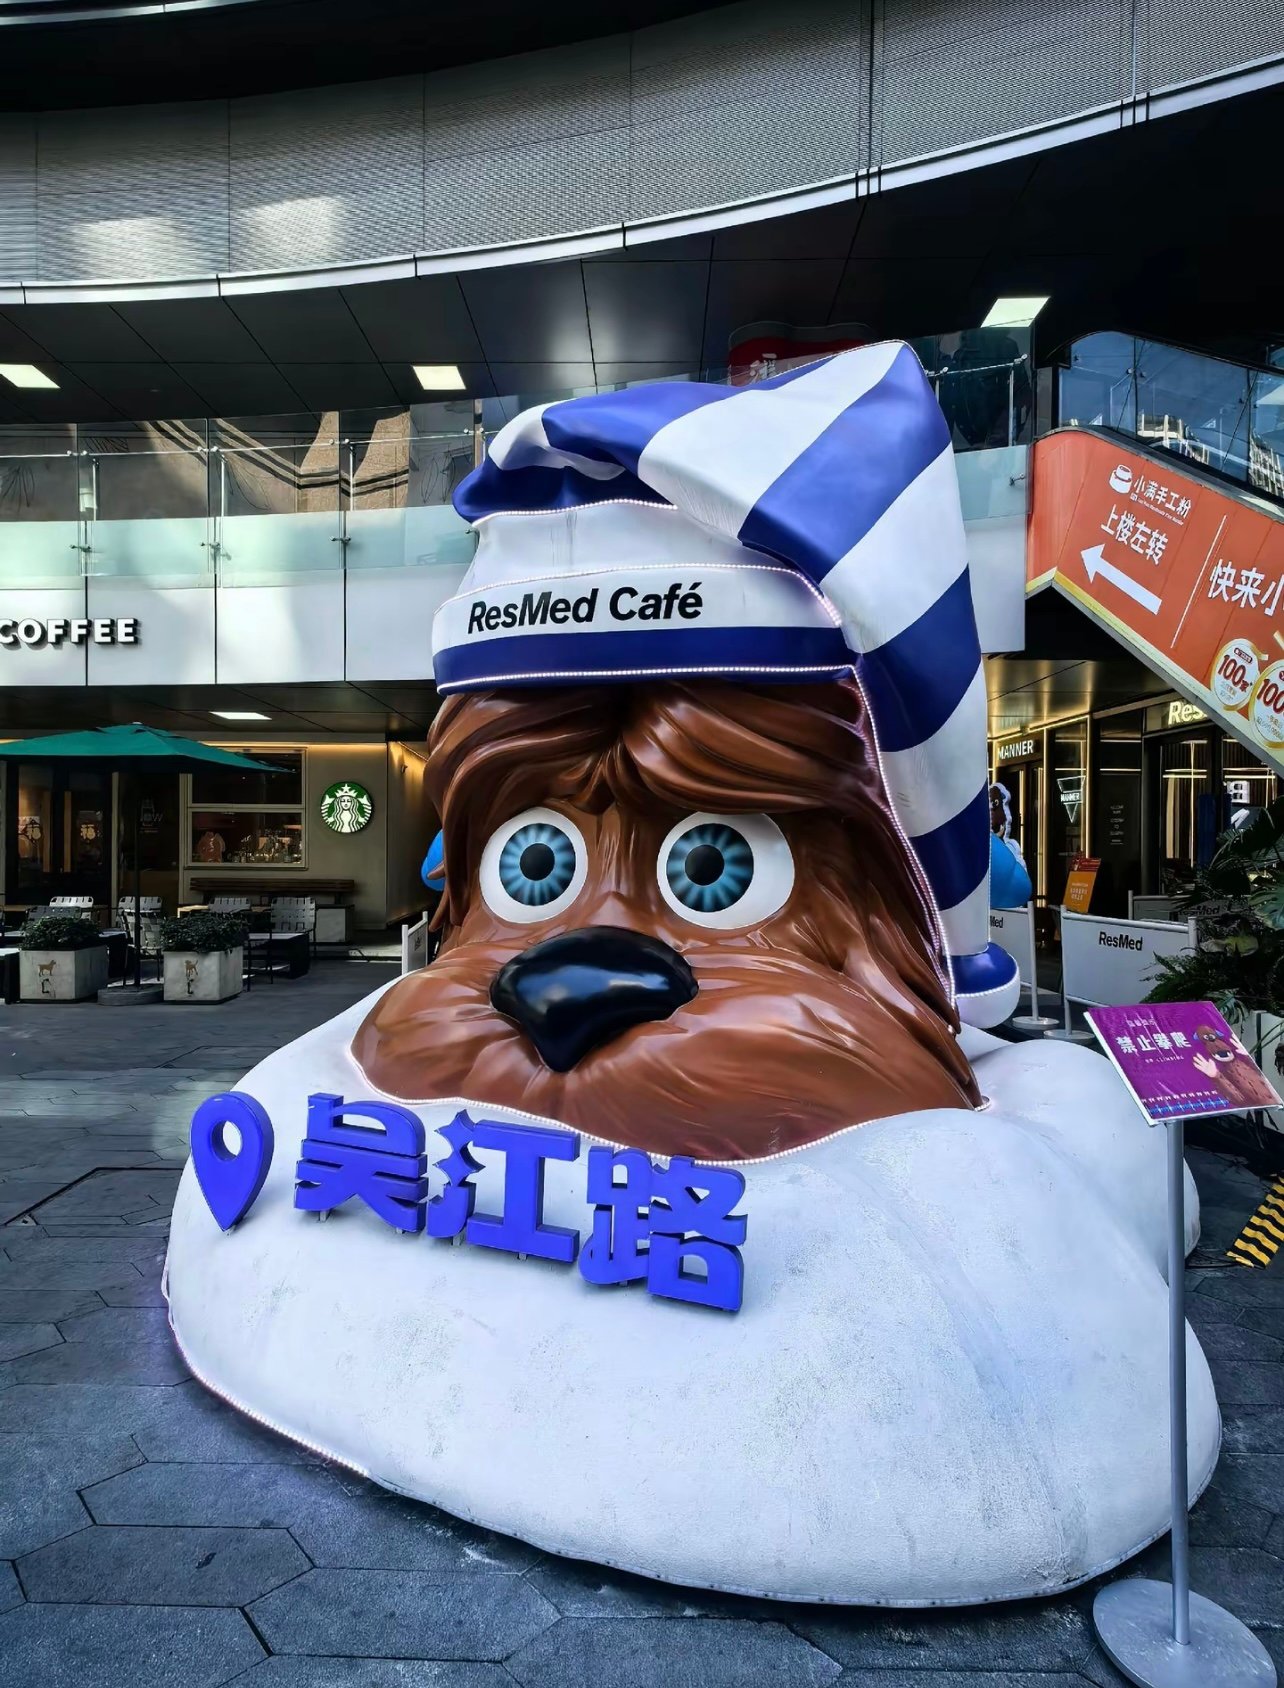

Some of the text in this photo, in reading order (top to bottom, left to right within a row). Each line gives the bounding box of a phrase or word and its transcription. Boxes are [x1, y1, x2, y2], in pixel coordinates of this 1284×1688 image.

[1133, 475, 1191, 519] 小满手工粉
[1100, 504, 1169, 565] 上楼左转
[467, 581, 703, 635] ResMed Café
[0, 618, 137, 645] COFFEE
[998, 740, 1034, 760] MANNER
[1099, 931, 1143, 951] ResMed
[1115, 1031, 1192, 1054] 禁止攀爬
[294, 1093, 749, 1312] 吴江路
